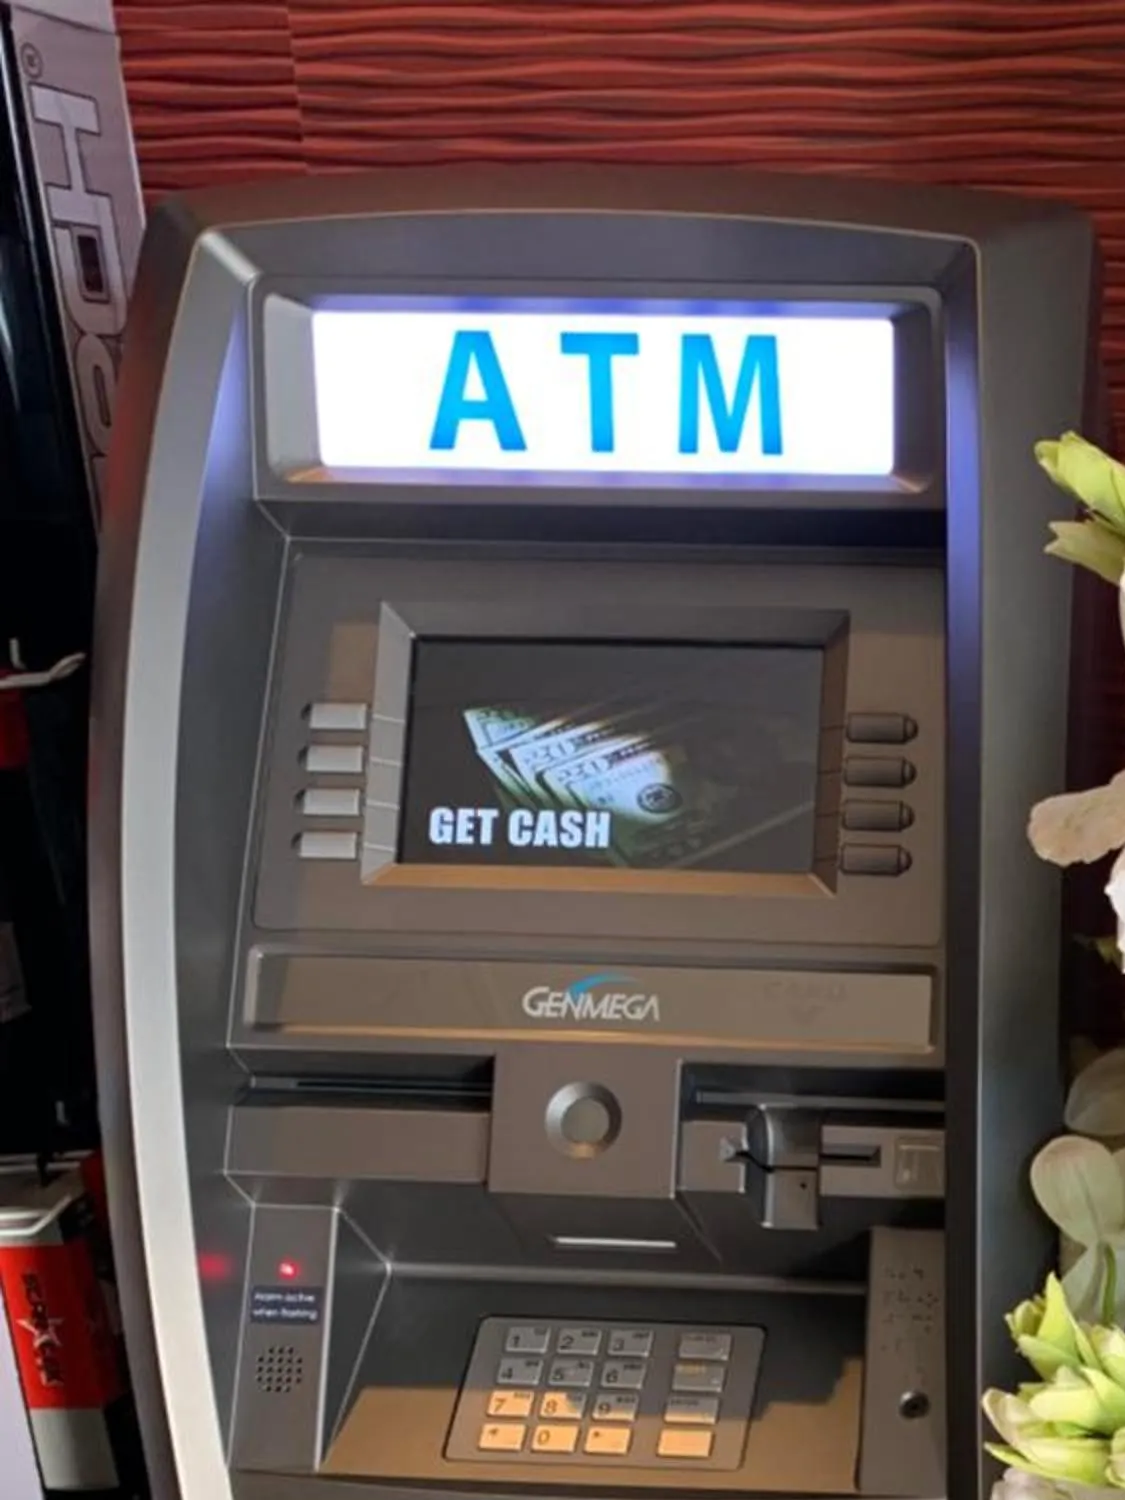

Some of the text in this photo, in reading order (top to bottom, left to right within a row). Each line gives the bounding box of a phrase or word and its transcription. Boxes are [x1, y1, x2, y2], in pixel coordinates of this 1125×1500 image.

[428, 329, 784, 456] ATM
[428, 807, 612, 848] GET CASH
[521, 985, 660, 1021] GENMEGA
[559, 1335, 574, 1350] 2
[605, 1368, 619, 1383] 6
[493, 1397, 507, 1413] 7
[543, 1399, 558, 1415] 8
[598, 1402, 611, 1416] 9
[537, 1429, 551, 1445] 0
